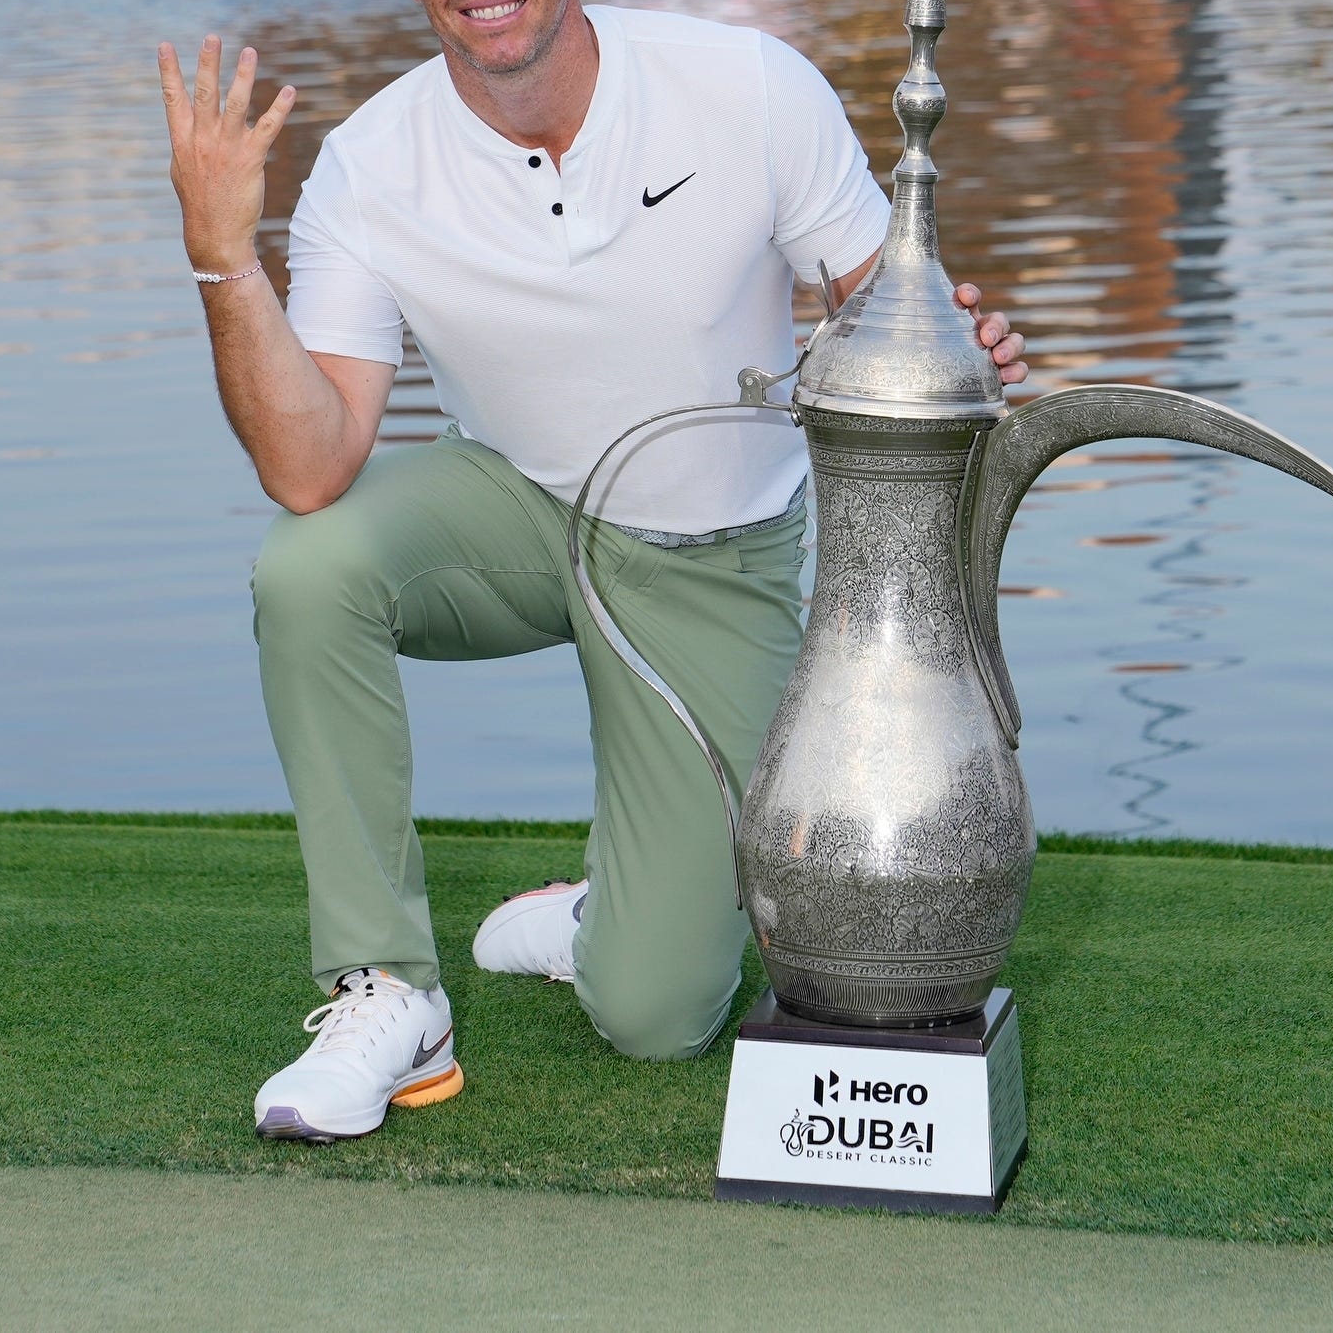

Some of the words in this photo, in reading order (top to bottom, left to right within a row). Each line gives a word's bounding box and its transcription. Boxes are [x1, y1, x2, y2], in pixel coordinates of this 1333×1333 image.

[850, 1080, 928, 1106] Hero
[807, 1115, 934, 1153] DUBAI
[807, 1149, 862, 1162] DESERT
[870, 1154, 932, 1167] CLASSIC
